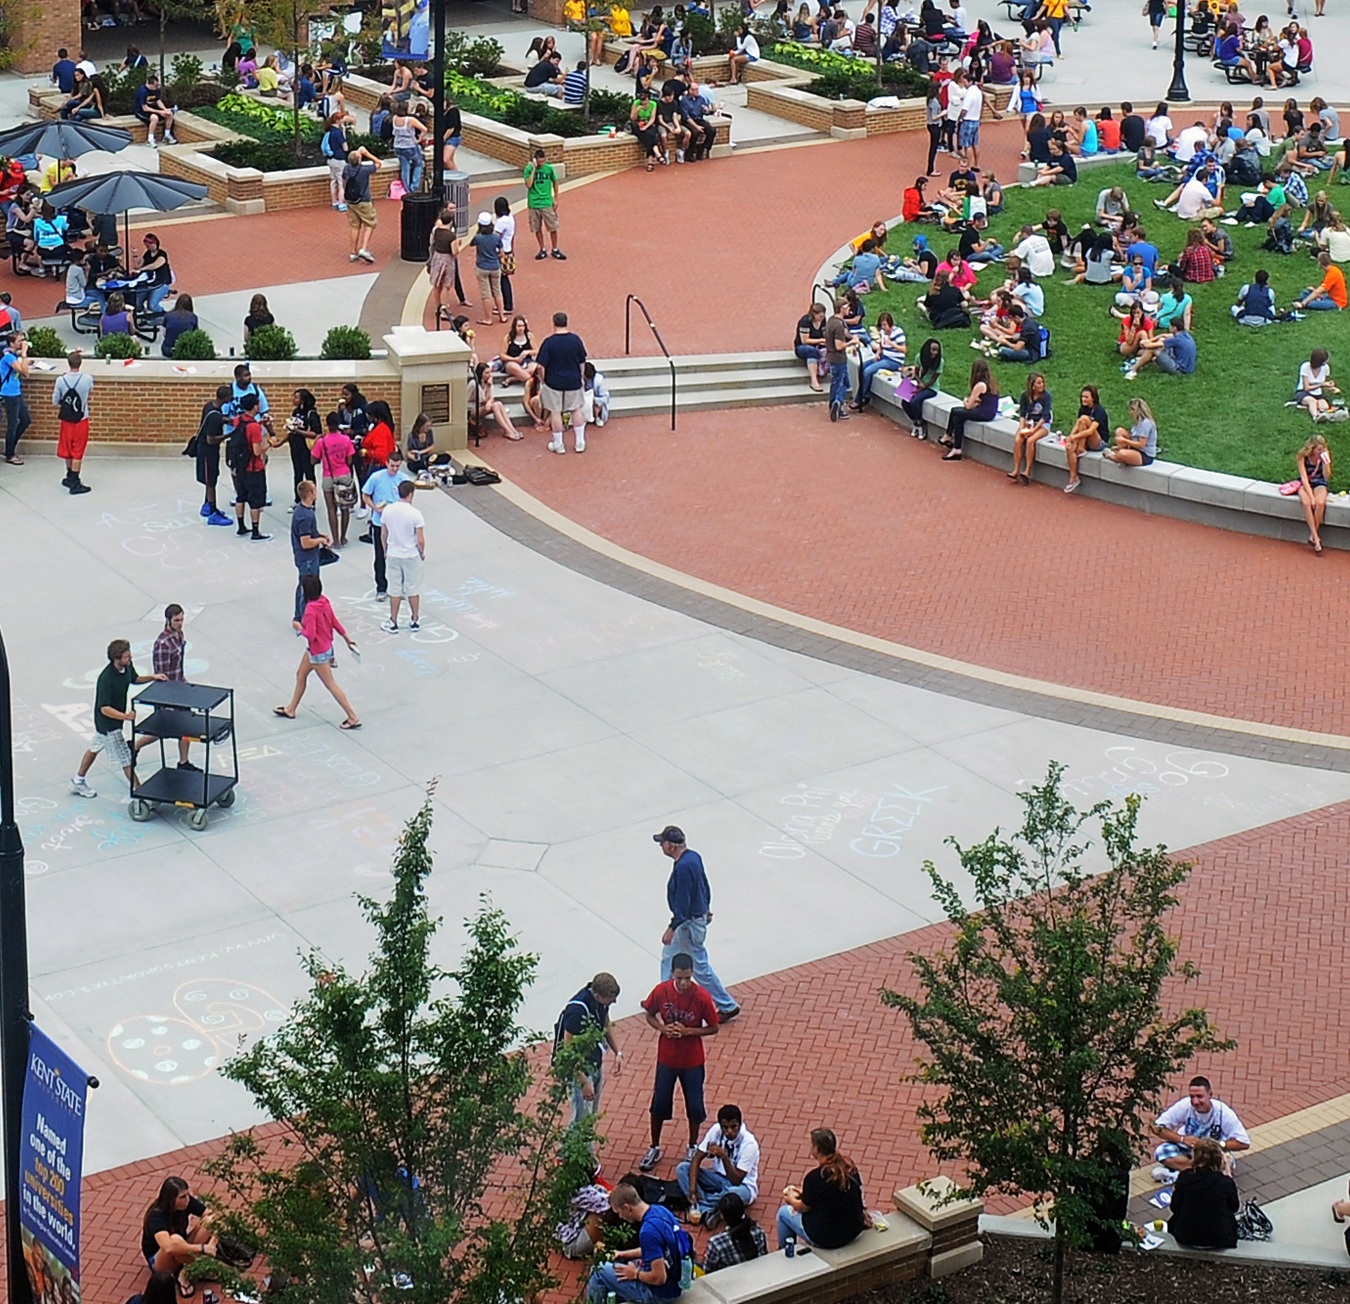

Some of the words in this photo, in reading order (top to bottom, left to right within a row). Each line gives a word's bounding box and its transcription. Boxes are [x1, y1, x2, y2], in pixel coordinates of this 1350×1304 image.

[30, 1052, 54, 1091] KENT
[54, 1076, 82, 1117] STATE
[30, 1132, 46, 1157] one
[47, 1145, 57, 1165] of
[56, 1154, 72, 1182] the
[36, 1112, 68, 1156] Named
[24, 1169, 74, 1227] universities
[34, 1156, 49, 1184] top
[49, 1170, 65, 1197] 200
[23, 1183, 32, 1202] in
[32, 1194, 47, 1221] the
